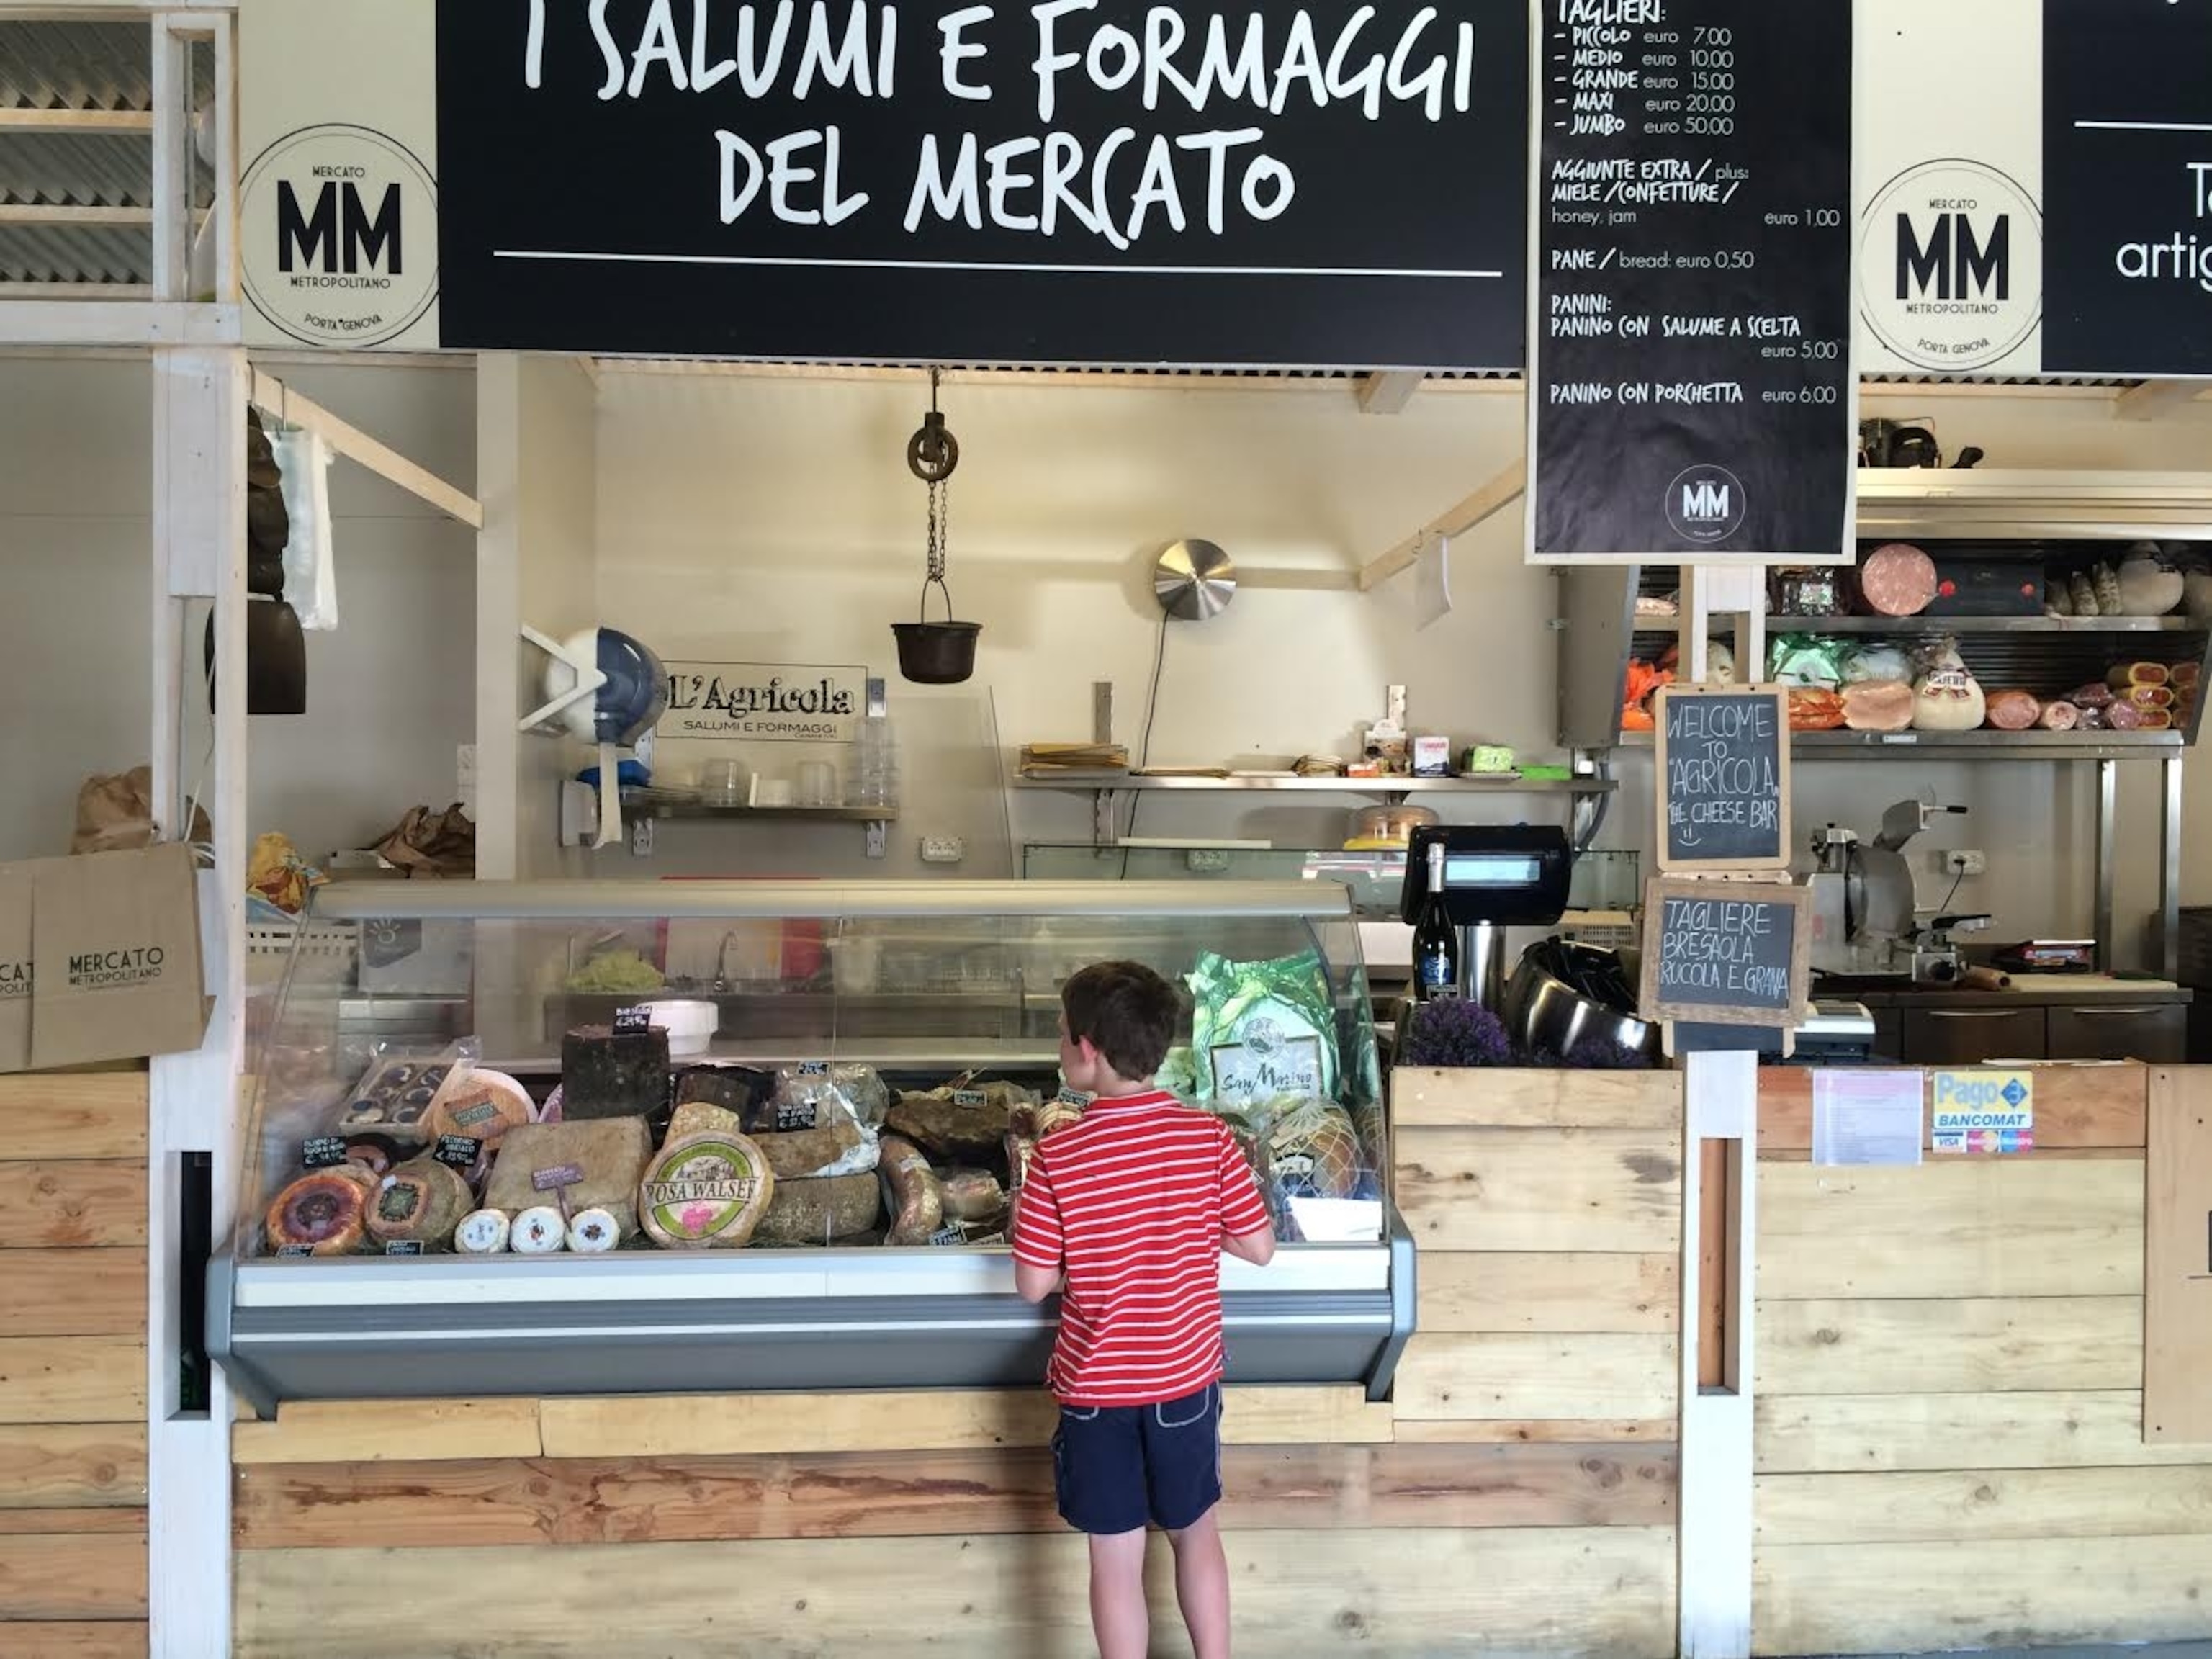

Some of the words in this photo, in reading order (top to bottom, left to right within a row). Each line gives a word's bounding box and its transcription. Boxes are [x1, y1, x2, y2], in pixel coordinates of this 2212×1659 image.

[1572, 26, 1632, 48] PICCOLO
[1643, 32, 1680, 43] euro
[526, 0, 545, 89] I
[588, 0, 897, 100] SALUMI
[937, 5, 995, 100] E
[1031, 0, 1474, 122] FORMAGGI
[1572, 49, 1623, 67] MEDIO
[1641, 54, 1678, 66] euro
[1572, 68, 1640, 89] GRANDE
[1642, 76, 1679, 89] euro
[1572, 91, 1614, 112] MAXI
[1645, 99, 1681, 112] euro
[1569, 114, 1626, 136] JUMBO
[1643, 122, 1680, 134] euro
[312, 166, 365, 178] MERCATO
[1551, 159, 1635, 181] AGGIUNTE
[1715, 163, 1749, 182] plus:
[714, 125, 870, 227] DEL
[903, 127, 1295, 251] MERCATO
[1929, 199, 1977, 210] MERCATO
[277, 180, 402, 274] MM
[1608, 210, 1637, 227] jam
[1764, 212, 1798, 225] euro
[1676, 255, 1711, 269] euro
[1896, 212, 2009, 300] MM
[290, 276, 391, 289] METROPOLITANO
[1551, 294, 1612, 315] PANINI:
[1906, 303, 1999, 315] METROPOLITANO
[304, 313, 338, 331] PORTA
[342, 313, 383, 331] GENOVA
[1551, 315, 1613, 338] PANINO
[1619, 315, 1650, 338] CON
[1661, 315, 1726, 337] SALUME
[1729, 317, 1742, 337] A
[1747, 315, 1802, 339] SCELTA
[1761, 346, 1797, 358] euro
[1917, 338, 1948, 354] PORTA
[1952, 338, 1991, 354] GENOVA
[1550, 382, 1612, 405] PANINO
[1618, 382, 1649, 405] CON
[1655, 382, 1744, 405] PORCHETTA
[1762, 390, 1796, 403] euro
[1683, 484, 1729, 518] MM
[668, 674, 855, 719] L'Agricola
[684, 721, 740, 731] SALUMI
[744, 722, 753, 732] E
[757, 722, 837, 734] FORMAGGI
[1666, 703, 1773, 742] WELCOME
[1701, 740, 1728, 760] TO
[1691, 801, 1746, 824] CHEESE
[1750, 799, 1778, 832] BAR
[1665, 900, 1771, 937] TAGLIERE
[1662, 930, 1755, 964] BRESAOLA
[69, 947, 164, 974] MERCATO
[69, 967, 162, 986] METROPOLITANO
[1660, 960, 1721, 989] RUCOLA
[1727, 966, 1743, 990] E
[1936, 1073, 1999, 1110] Pago
[1939, 1114, 2026, 1126] BANCOMAT
[1939, 1138, 1959, 1146] VISA
